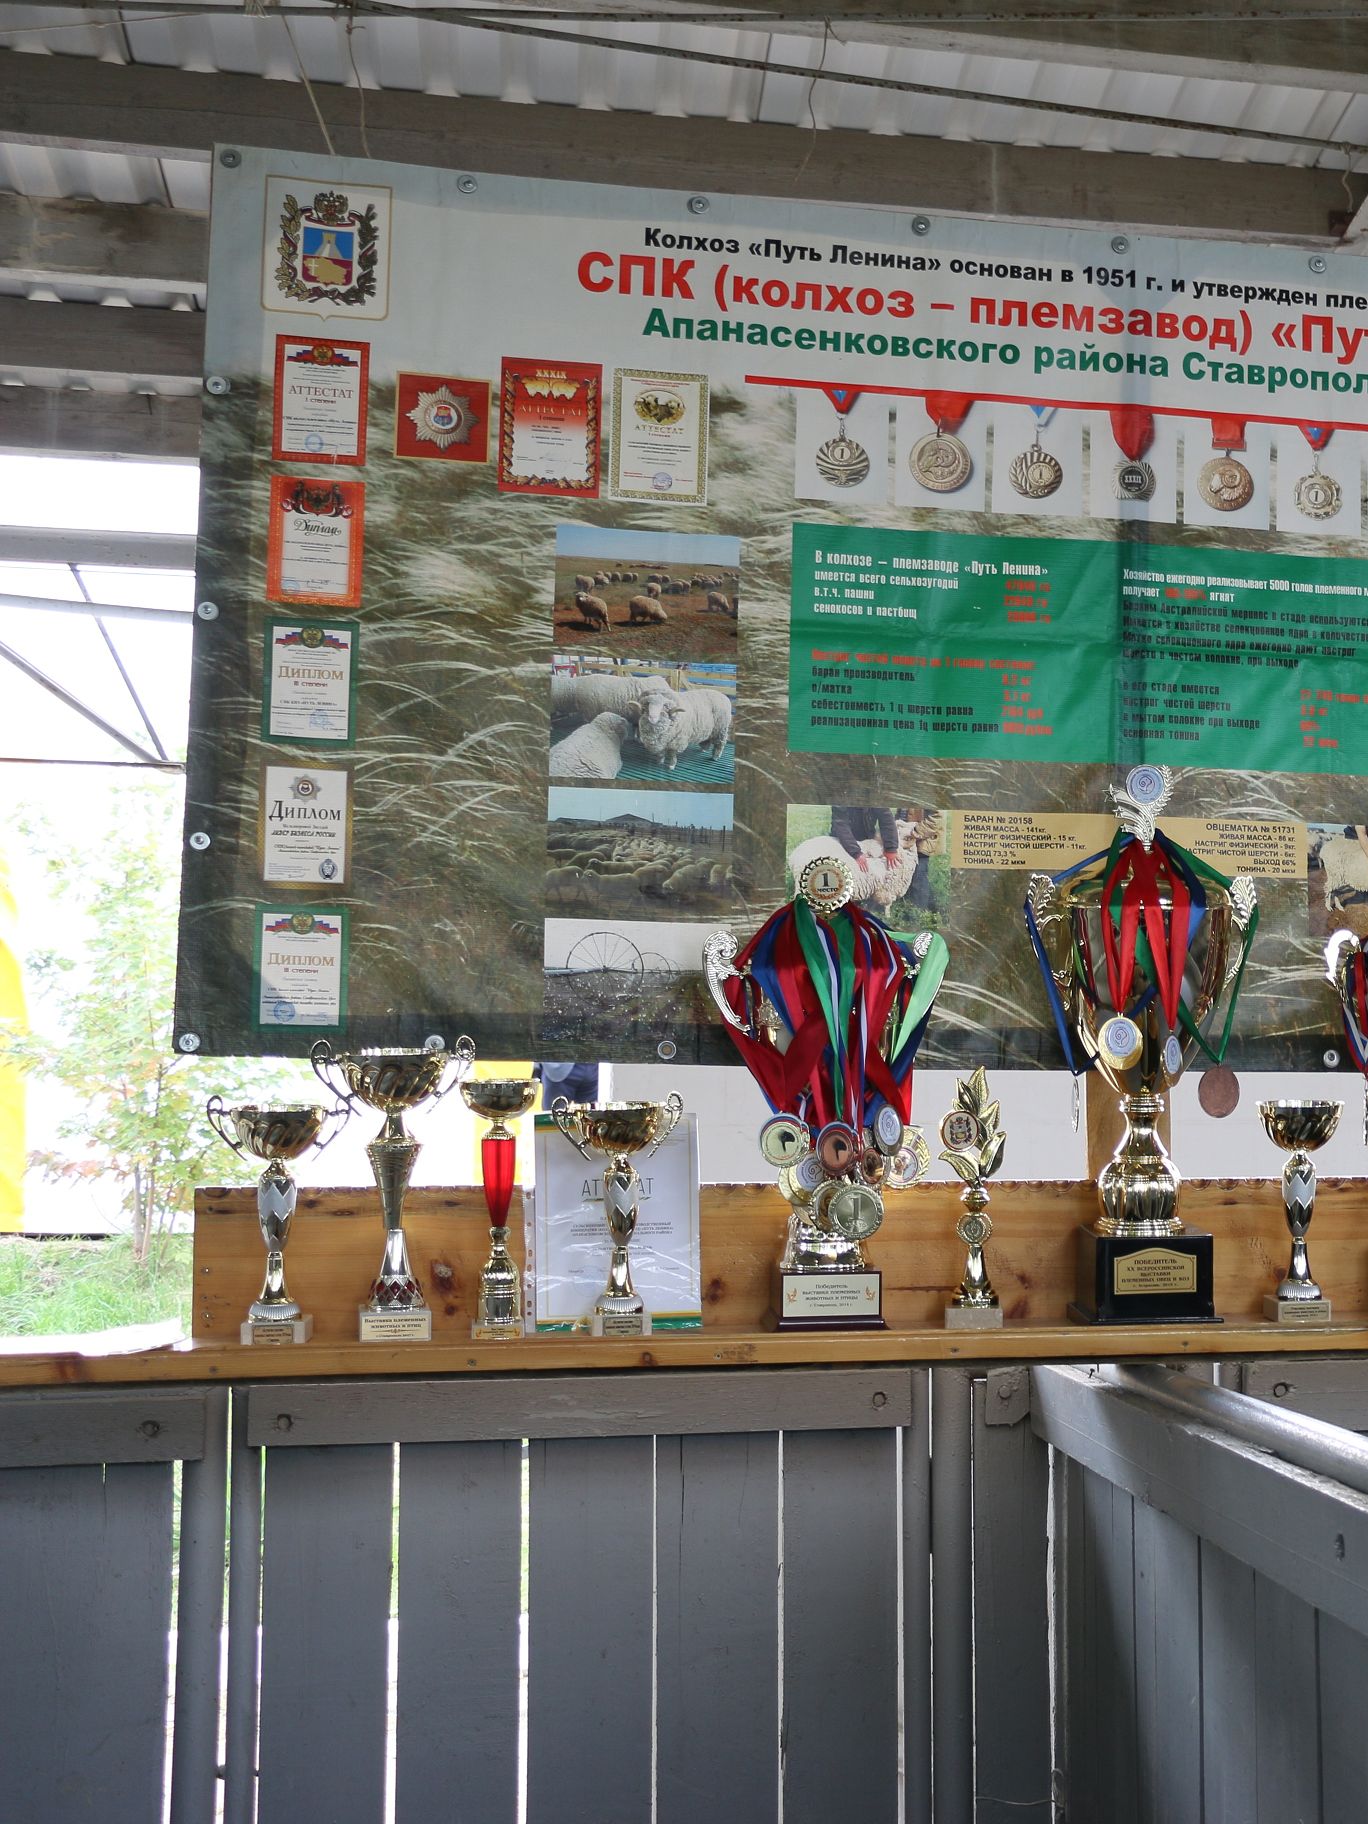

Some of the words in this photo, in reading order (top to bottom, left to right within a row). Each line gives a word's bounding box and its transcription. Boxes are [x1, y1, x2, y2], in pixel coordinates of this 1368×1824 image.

[645, 227, 740, 254] Колхоз
[749, 238, 822, 264] «Путь
[830, 246, 941, 272] Ленина»
[950, 257, 1052, 282] основан
[1061, 269, 1074, 283] в
[1082, 266, 1137, 288] 1951
[1146, 277, 1163, 291] г.
[1171, 278, 1185, 292] и
[1193, 279, 1318, 307] утвержден
[577, 251, 696, 300] СПК
[714, 264, 915, 319] (колхоз
[970, 296, 1254, 357] племзавод)
[642, 307, 1021, 366] Апанасенковского
[1033, 343, 1170, 378] района
[536, 369, 567, 379] XXXIX
[289, 385, 354, 399] АТТЕСТАТ
[519, 405, 582, 417] АТТЕСТАТ
[635, 424, 684, 435] АТТЕСТАТ
[815, 550, 822, 563] В
[827, 553, 872, 567] колхозе
[892, 557, 959, 573] племзаводе
[964, 560, 997, 576] «Путь
[1002, 562, 1048, 575] Ленина»
[814, 570, 855, 582] имеется
[859, 573, 886, 585] всего
[890, 574, 959, 589] сельхозугодий
[1123, 568, 1165, 583] Хозяйство
[1166, 574, 1205, 586] ежегодно
[1207, 576, 1270, 590] реализовывает
[1270, 579, 1290, 592] 5000
[1291, 582, 1313, 593] голов
[1315, 584, 1362, 596] племенного
[845, 588, 874, 599] пашни
[1123, 585, 1160, 598] получает
[1210, 591, 1235, 602] ягнят
[814, 603, 863, 615] сенокосов
[876, 606, 917, 619] пастбищ
[278, 665, 344, 680] Диплом
[844, 668, 916, 681] производитель
[811, 699, 886, 712] себестоимость
[946, 706, 974, 717] равна
[811, 715, 889, 728] реализационная
[268, 800, 341, 821] Диплом
[964, 814, 994, 824] БАРАН
[1008, 817, 1033, 825] 20158
[1206, 823, 1258, 832] ОВЦЕМАТКА
[1000, 833, 1052, 841] ФИЗИЧЕСКИЙ
[1229, 841, 1279, 849] ФИЗИЧЕСКИЙ
[822, 872, 829, 887] 1
[267, 952, 335, 967] Диплом
[582, 1177, 654, 1196] АТАТ
